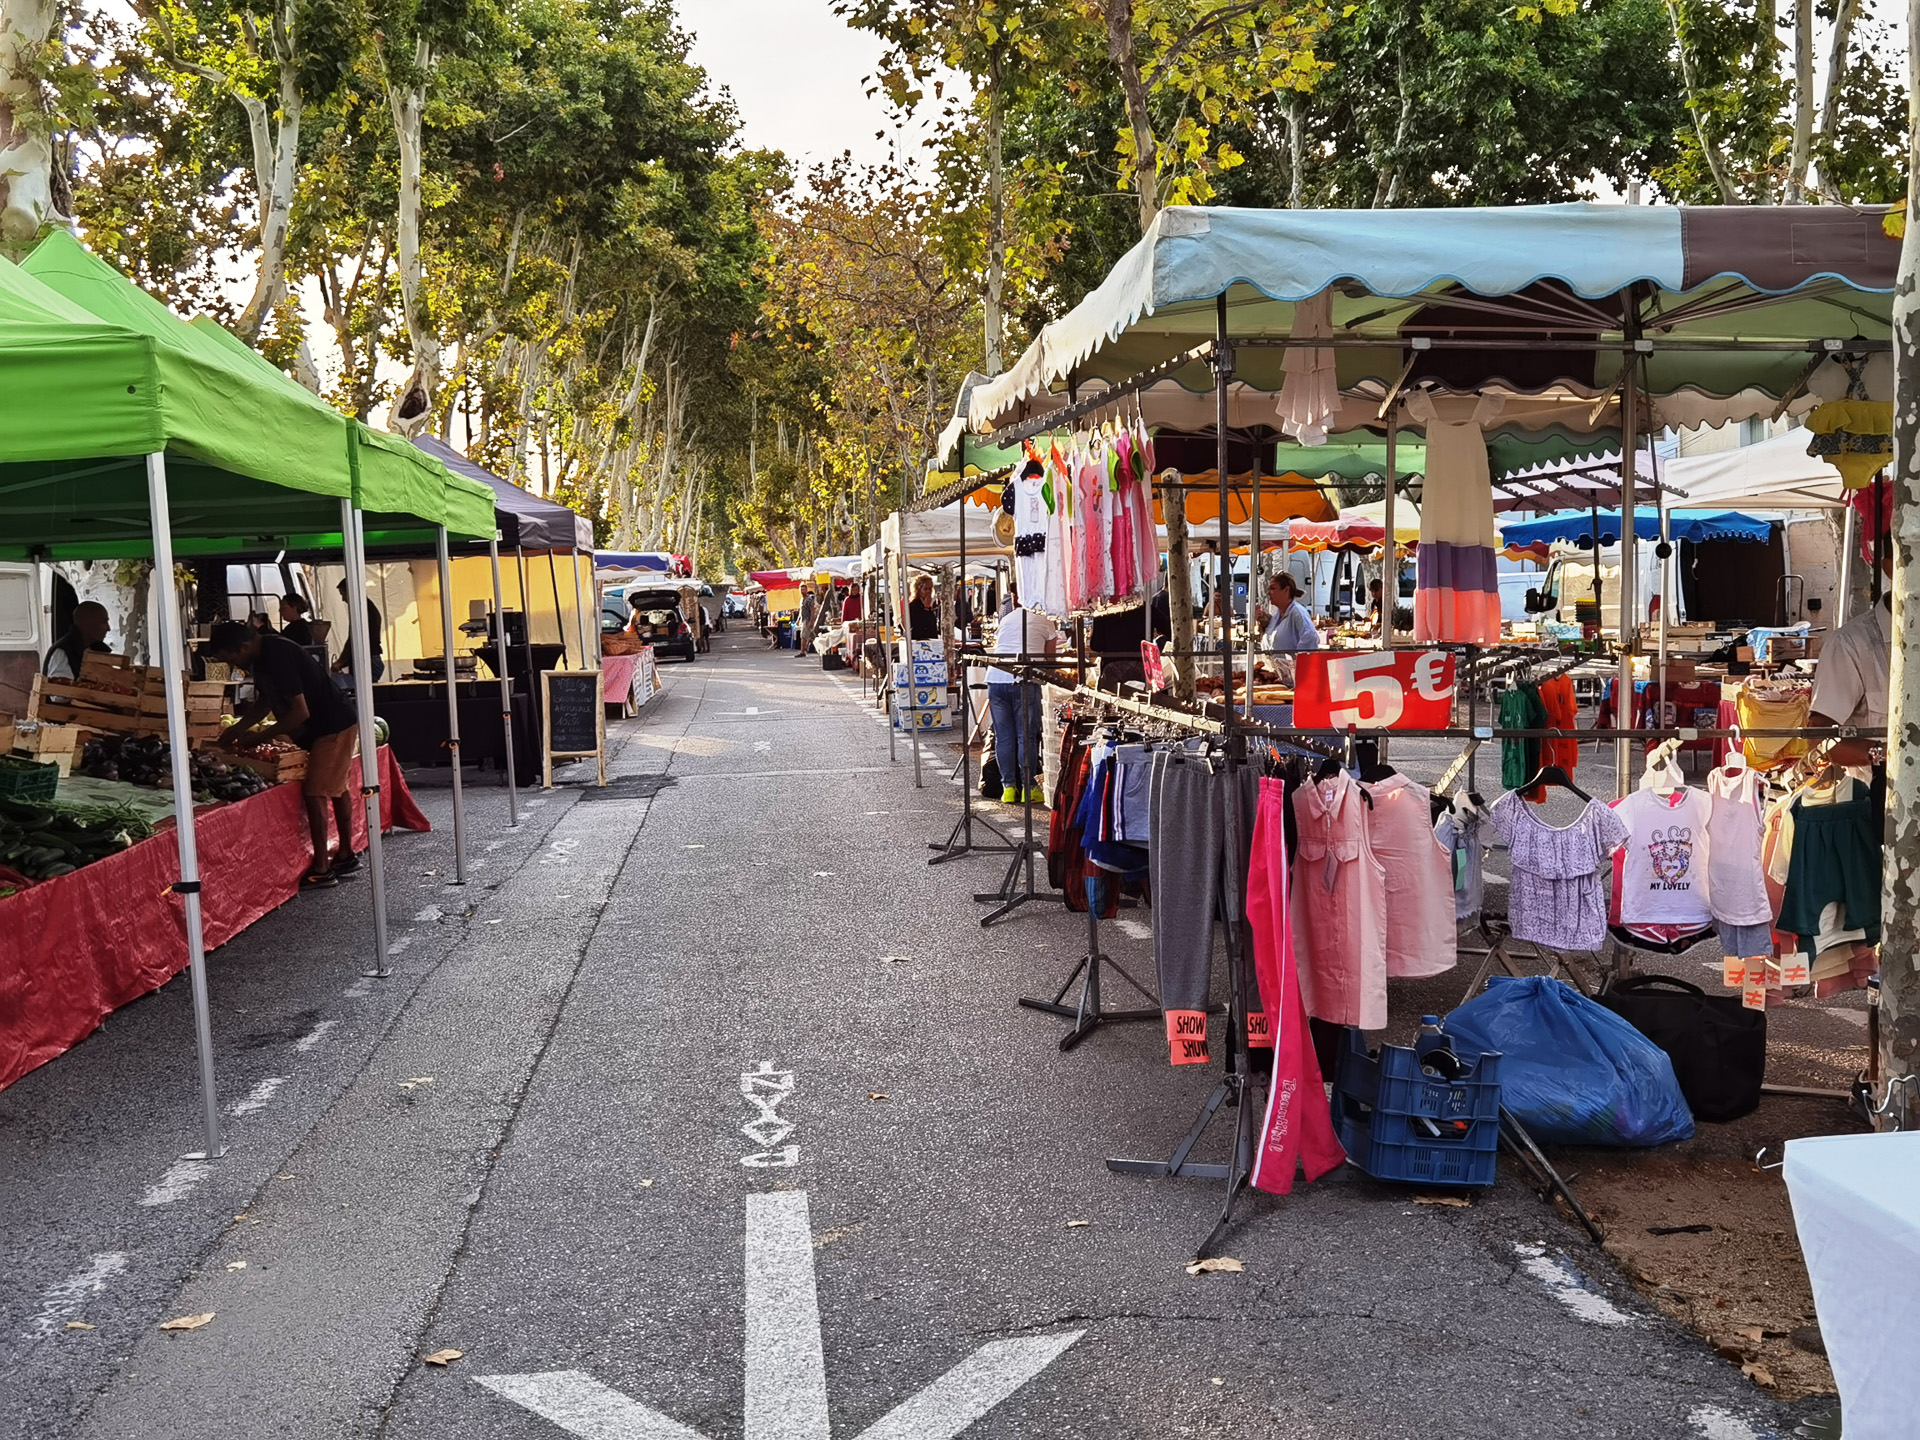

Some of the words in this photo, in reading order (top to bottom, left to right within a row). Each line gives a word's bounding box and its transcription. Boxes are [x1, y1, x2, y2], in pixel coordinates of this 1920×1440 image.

[1649, 882, 1661, 891] MY
[1662, 882, 1691, 891] LOVELY
[1176, 1016, 1206, 1035] SHOW
[1248, 1016, 1268, 1035] SHO
[1268, 1078, 1298, 1153] Beautiful
